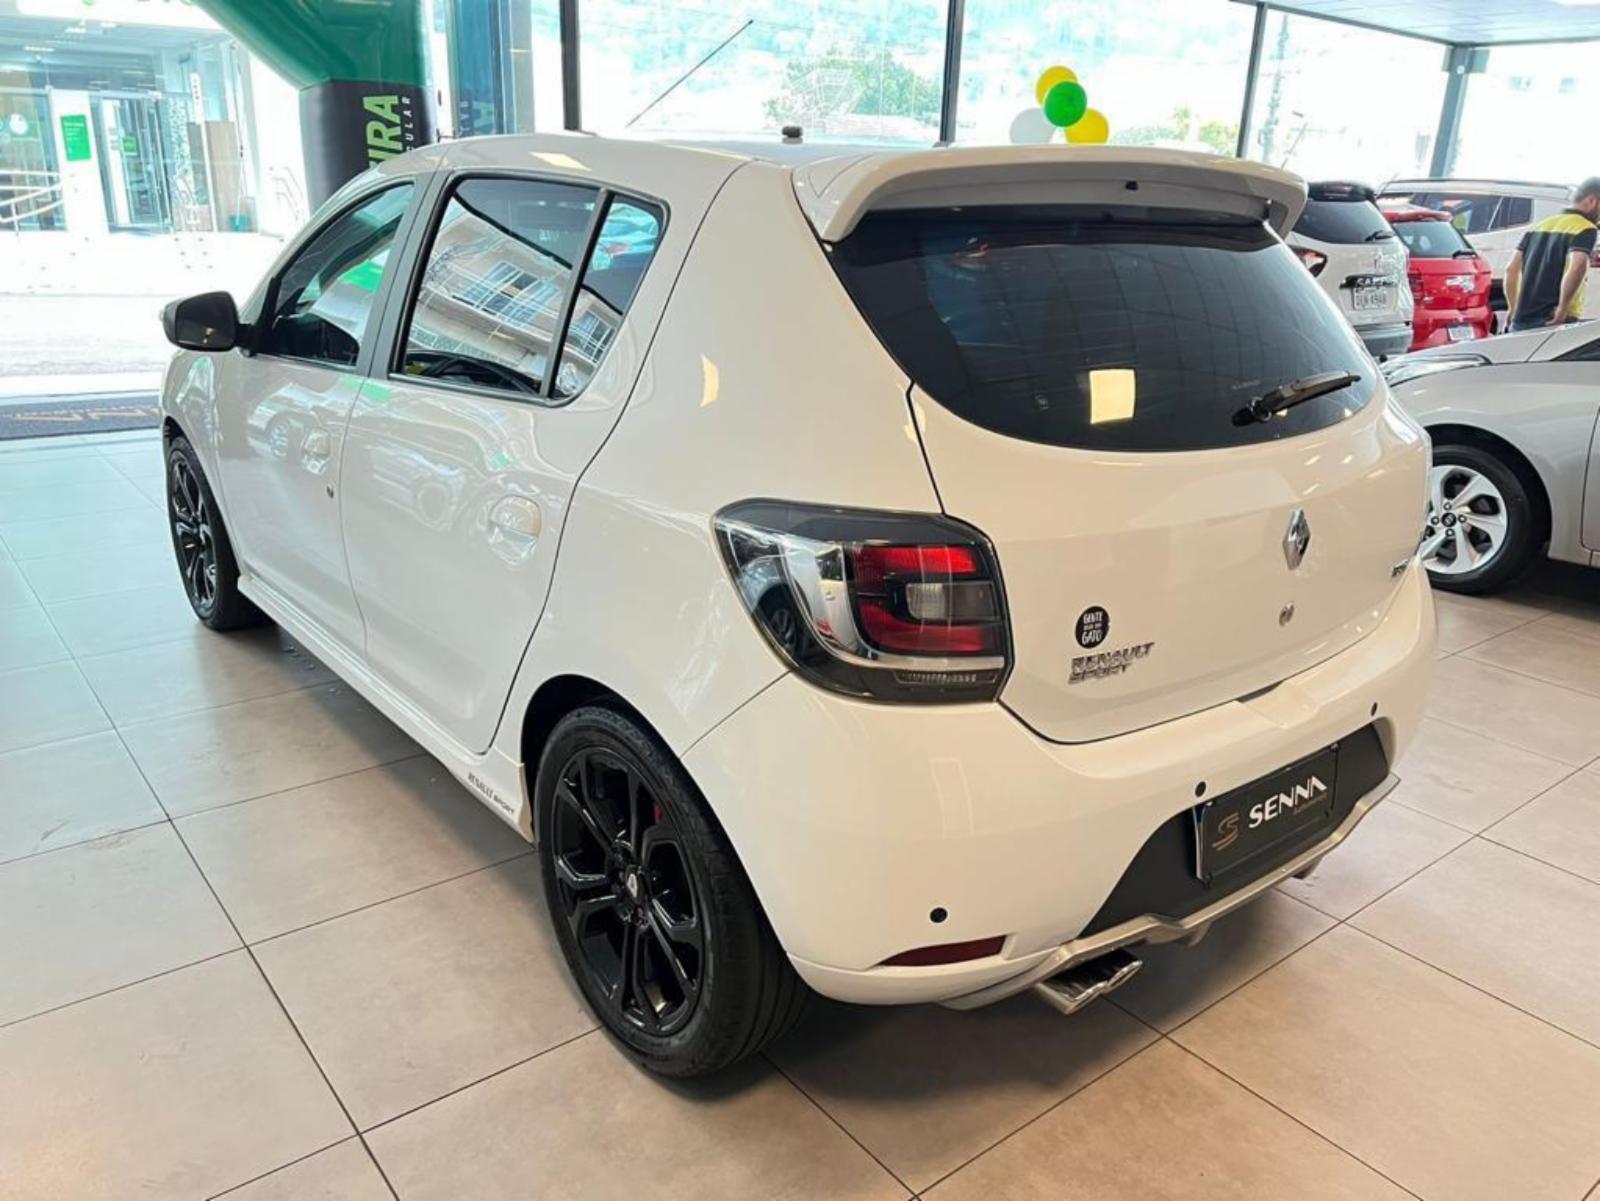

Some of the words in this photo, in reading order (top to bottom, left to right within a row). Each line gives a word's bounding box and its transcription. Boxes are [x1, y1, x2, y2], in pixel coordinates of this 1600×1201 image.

[363, 95, 403, 167] IRA
[1071, 642, 1155, 675] RENAULT
[1248, 776, 1328, 829] SENNA
